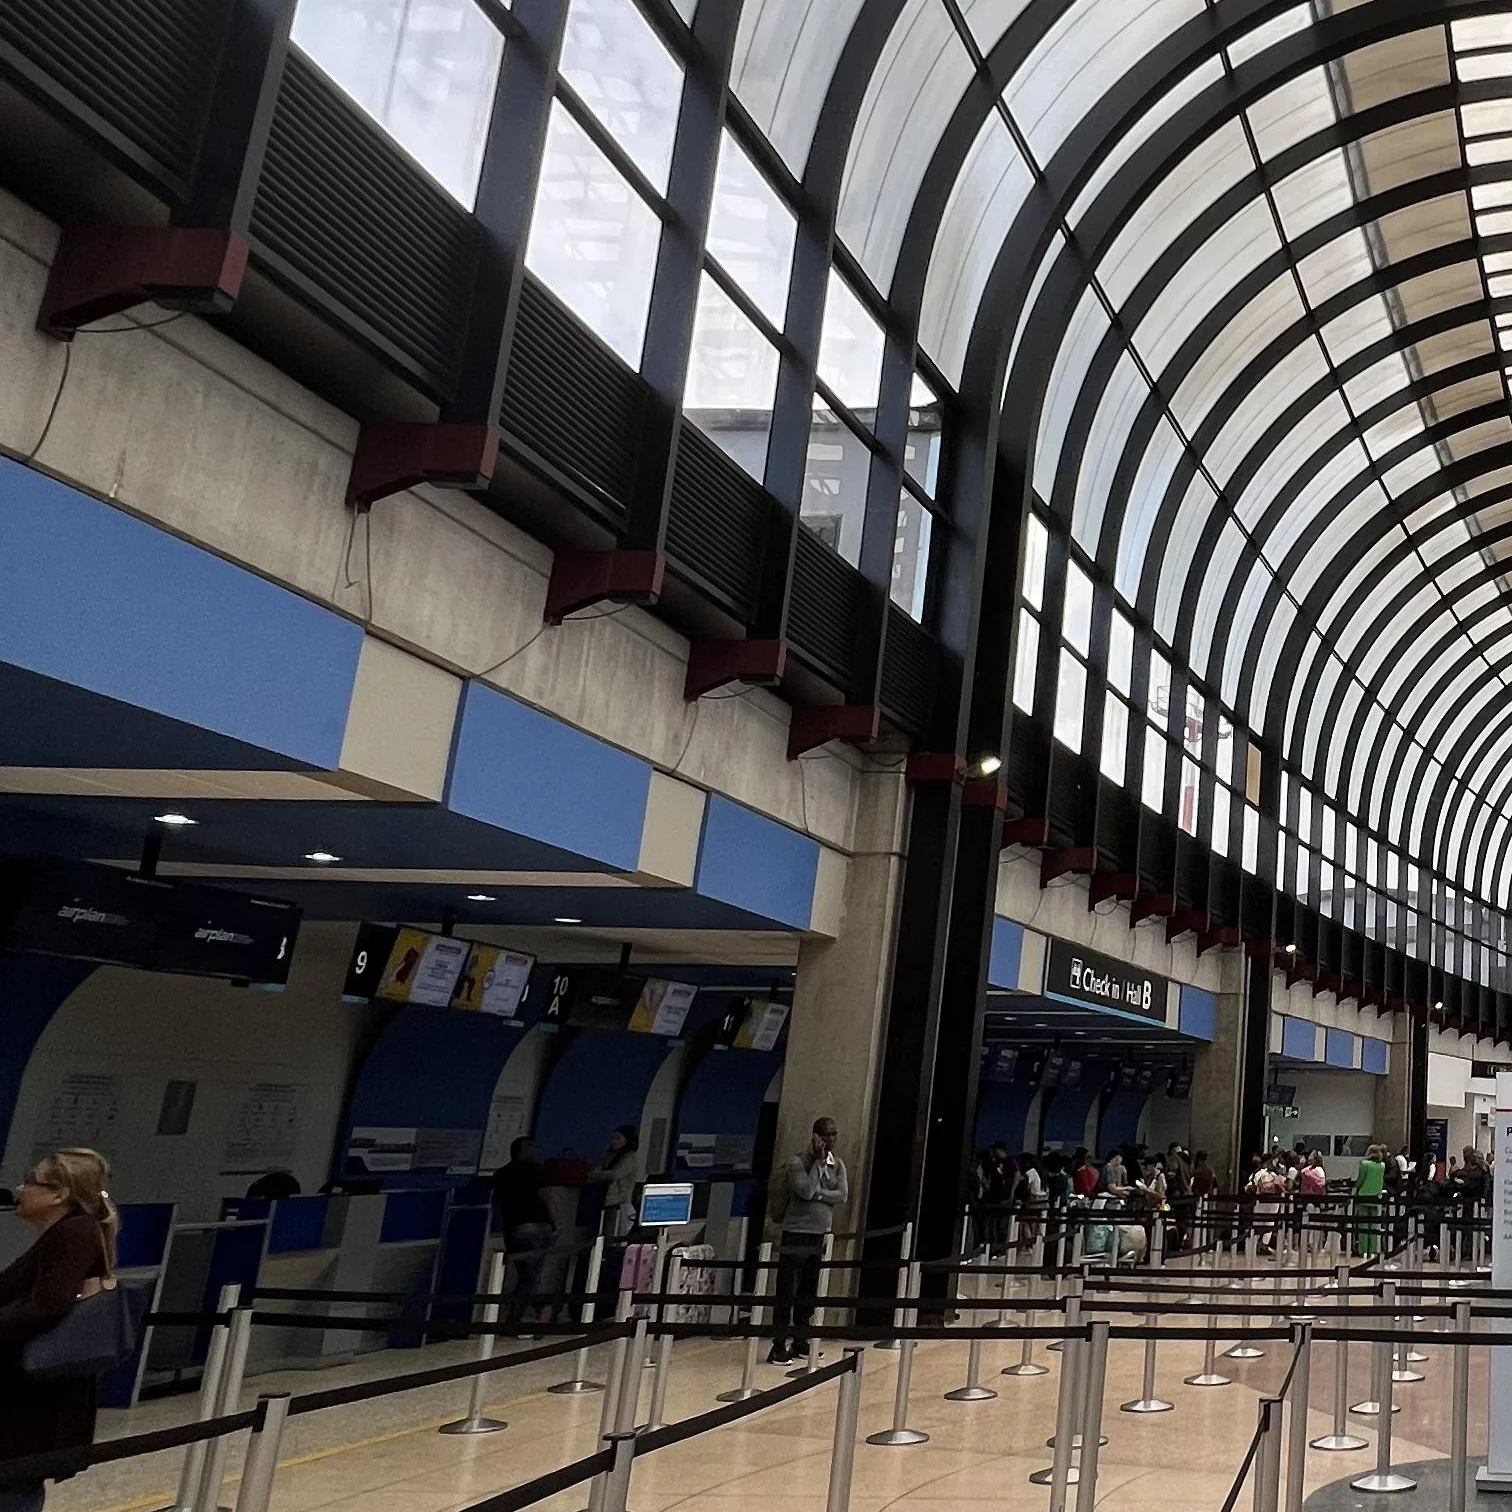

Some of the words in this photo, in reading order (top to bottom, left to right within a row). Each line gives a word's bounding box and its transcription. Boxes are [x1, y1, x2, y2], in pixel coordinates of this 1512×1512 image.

[355, 951, 368, 974] 9
[553, 975, 569, 996] 10
[1083, 967, 1110, 997] Check
[1111, 977, 1120, 1000] in
[1126, 981, 1141, 1006] Hall
[1142, 980, 1152, 1010] B
[547, 996, 559, 1016] A
